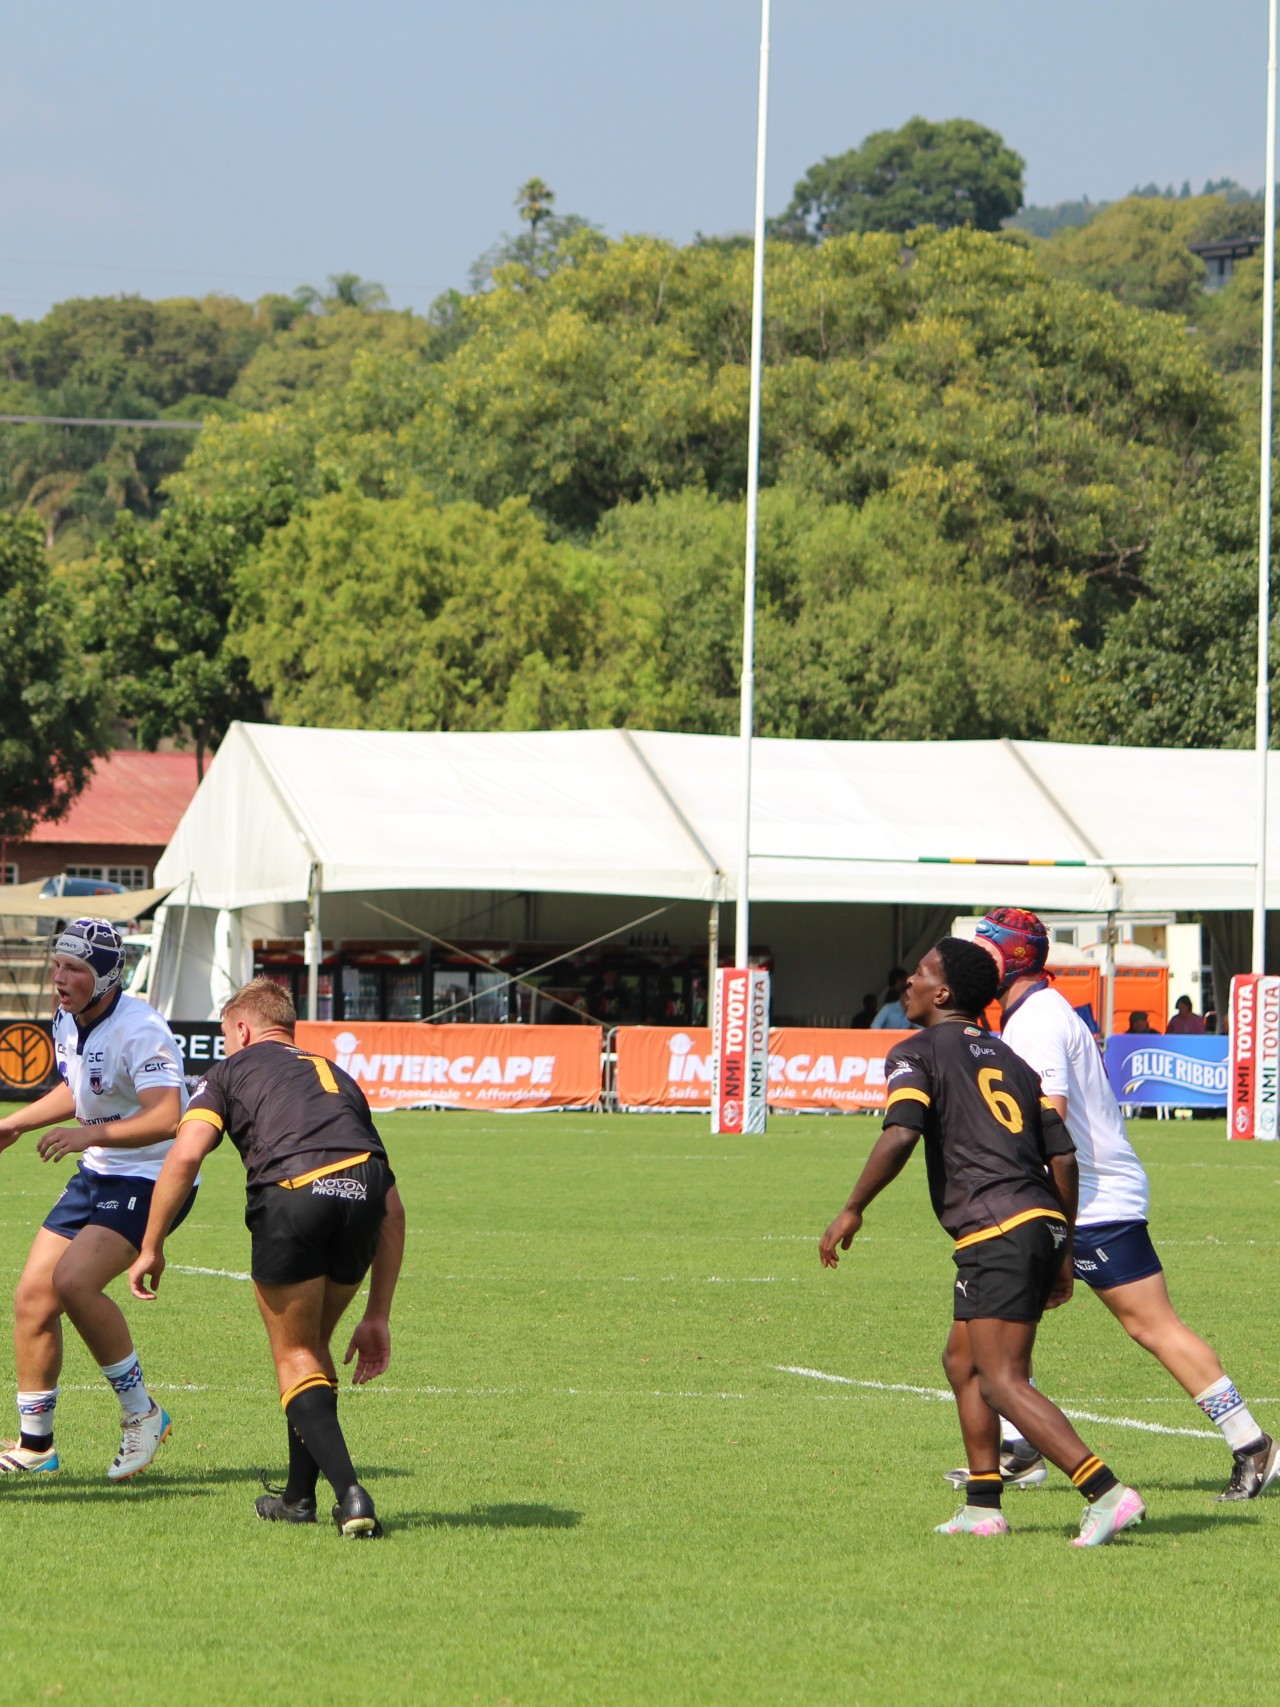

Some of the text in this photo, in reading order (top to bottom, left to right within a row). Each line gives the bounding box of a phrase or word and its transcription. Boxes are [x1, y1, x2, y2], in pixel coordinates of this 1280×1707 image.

[725, 977, 746, 1097] NMI TOYOTA
[751, 980, 765, 1097] NMI TOYOTA
[1236, 984, 1253, 1103] NMI TOYOTA
[981, 1048, 996, 1056] UFS
[1262, 987, 1280, 1103] NMI TOYOTA
[145, 1062, 170, 1073] GIC
[1040, 1068, 1056, 1078] IC
[1131, 1053, 1228, 1090] BLUE RIBBO
[476, 1087, 552, 1101] Affordable
[670, 1085, 699, 1098] Safe
[812, 1088, 886, 1102] Affordable
[977, 1067, 1024, 1134] 6
[312, 1178, 367, 1192] NOVON
[312, 1187, 366, 1201] PROTECTA
